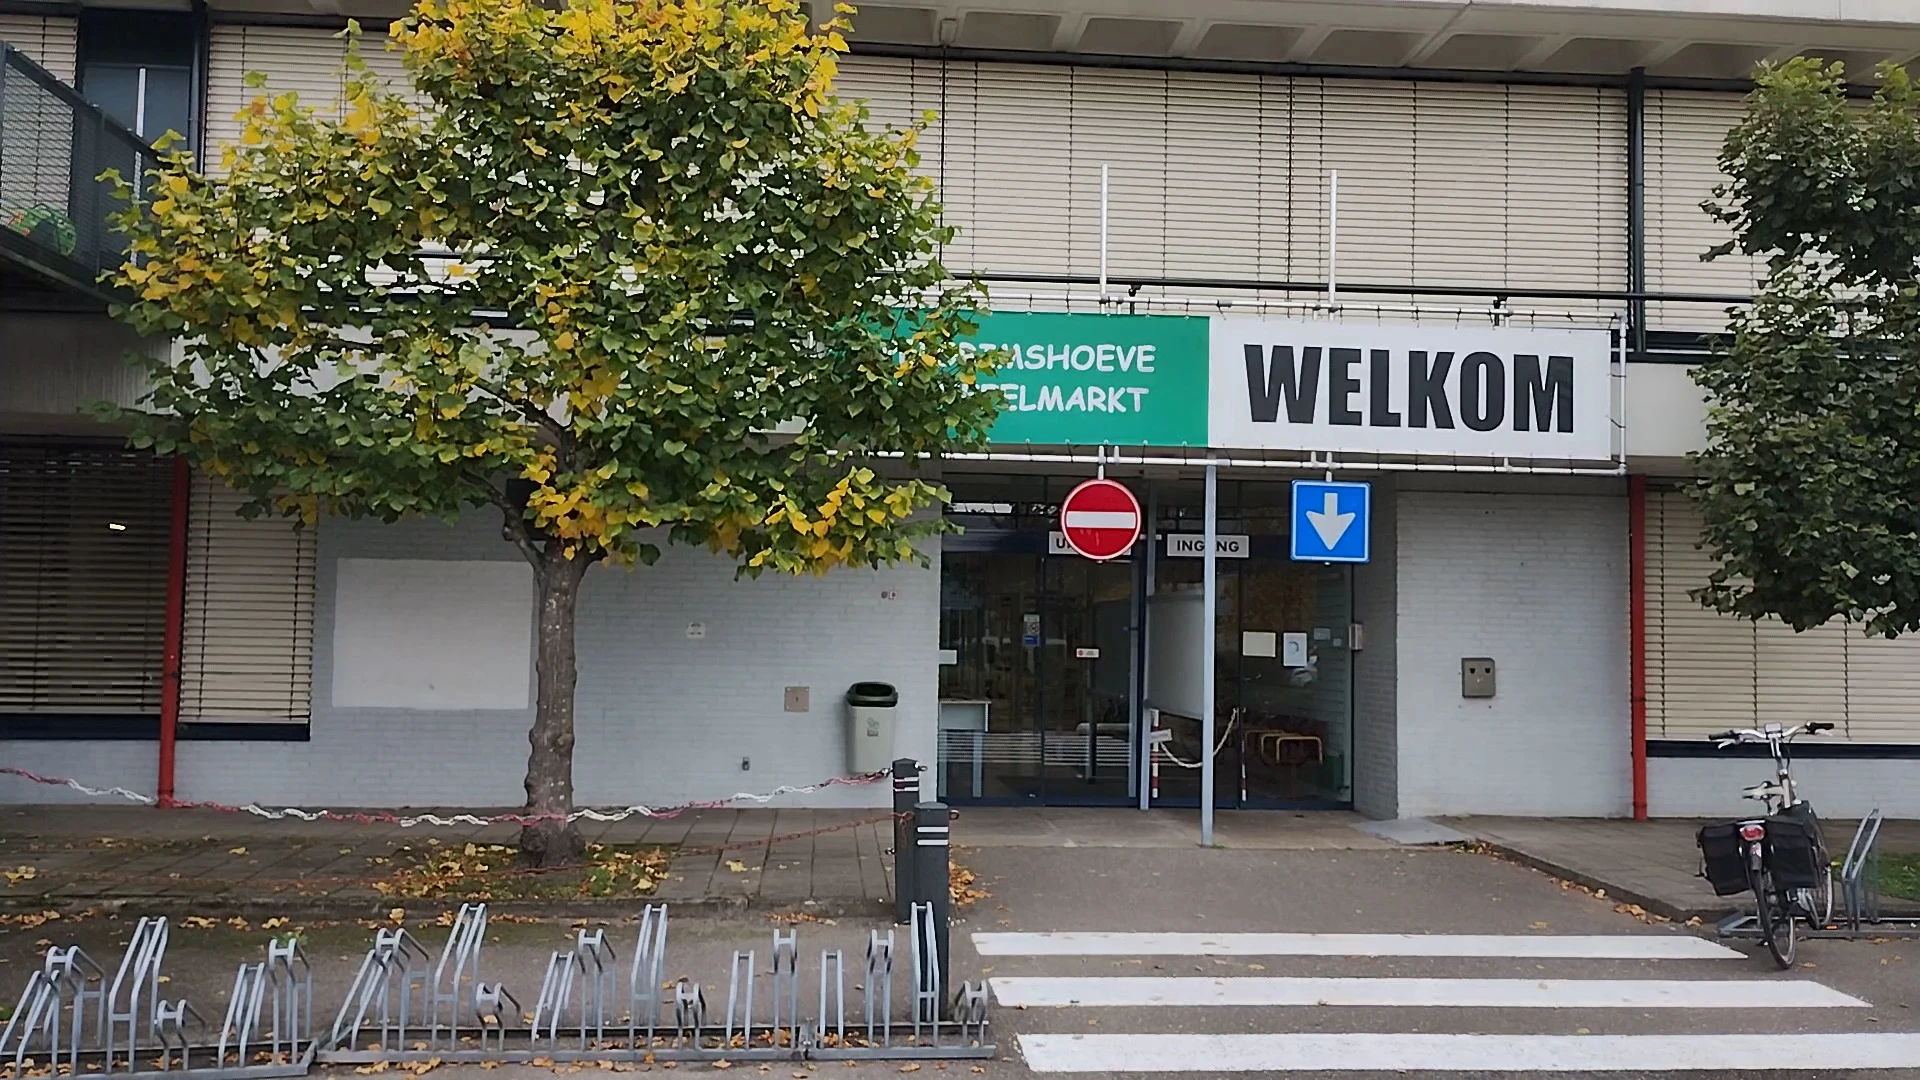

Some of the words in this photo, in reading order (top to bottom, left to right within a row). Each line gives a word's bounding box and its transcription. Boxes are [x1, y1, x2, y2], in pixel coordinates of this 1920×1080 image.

[884, 340, 1156, 372] RMSHOEVE
[900, 384, 1150, 413] ELMARKT
[1244, 344, 1574, 433] WELKOM
[1176, 539, 1239, 552] INGNG
